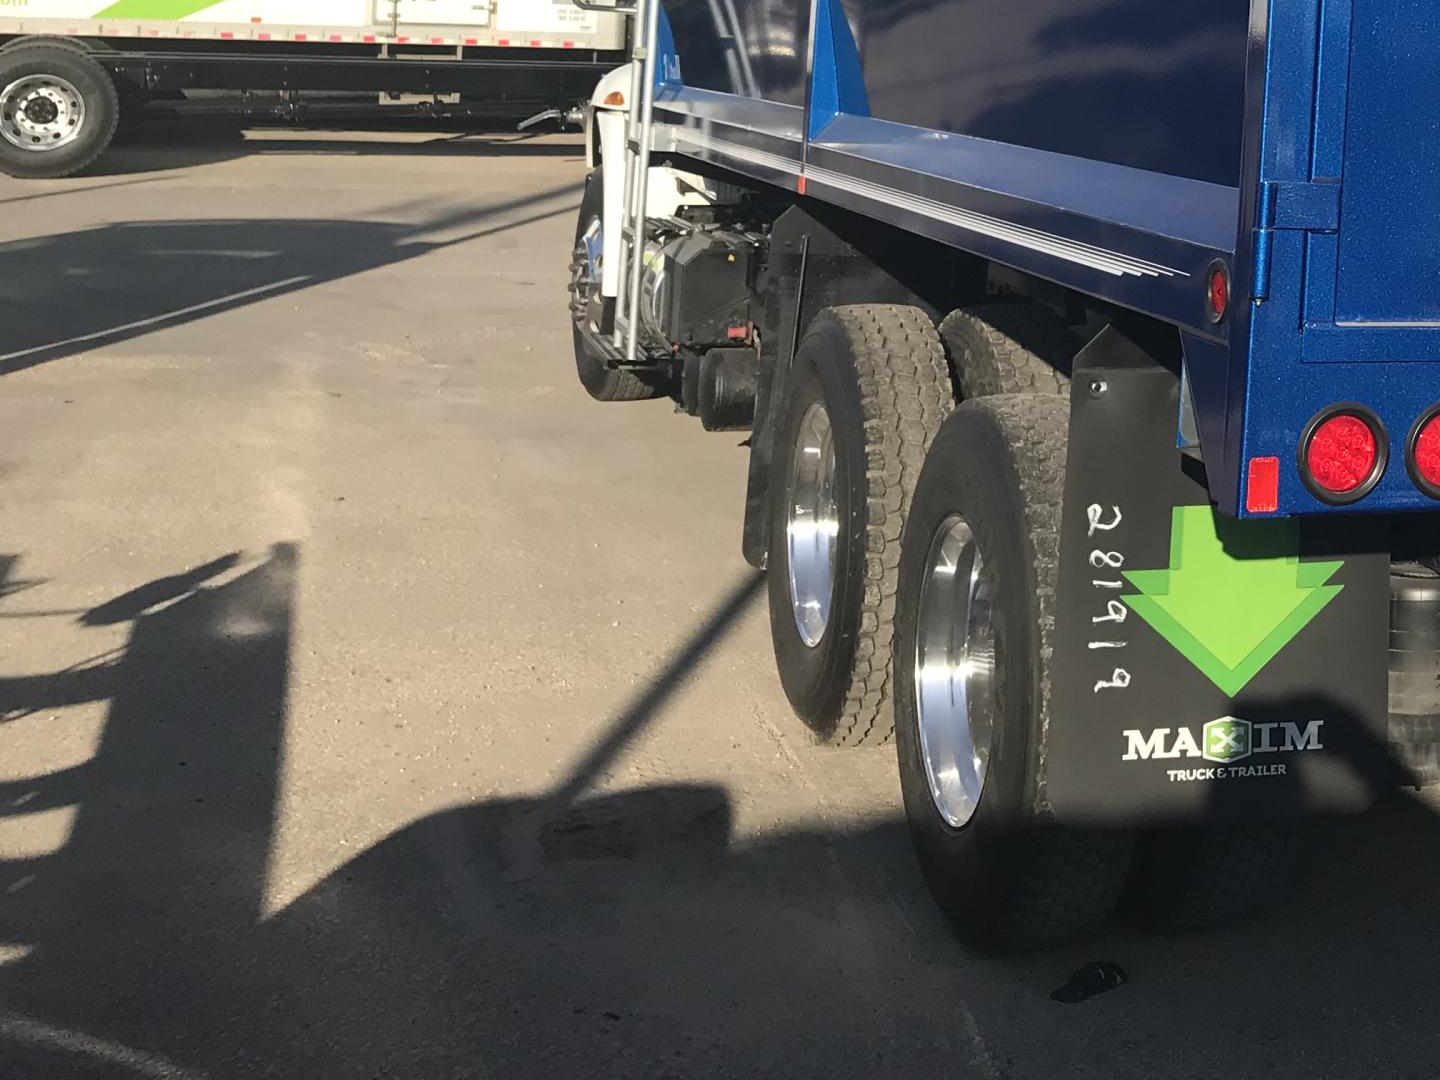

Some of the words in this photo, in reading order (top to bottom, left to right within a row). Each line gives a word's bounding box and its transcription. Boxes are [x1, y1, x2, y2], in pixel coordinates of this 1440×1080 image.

[1121, 715, 1325, 764] MAXIM
[1166, 768, 1215, 782] TRUCK
[1228, 764, 1287, 778] TRAILER
